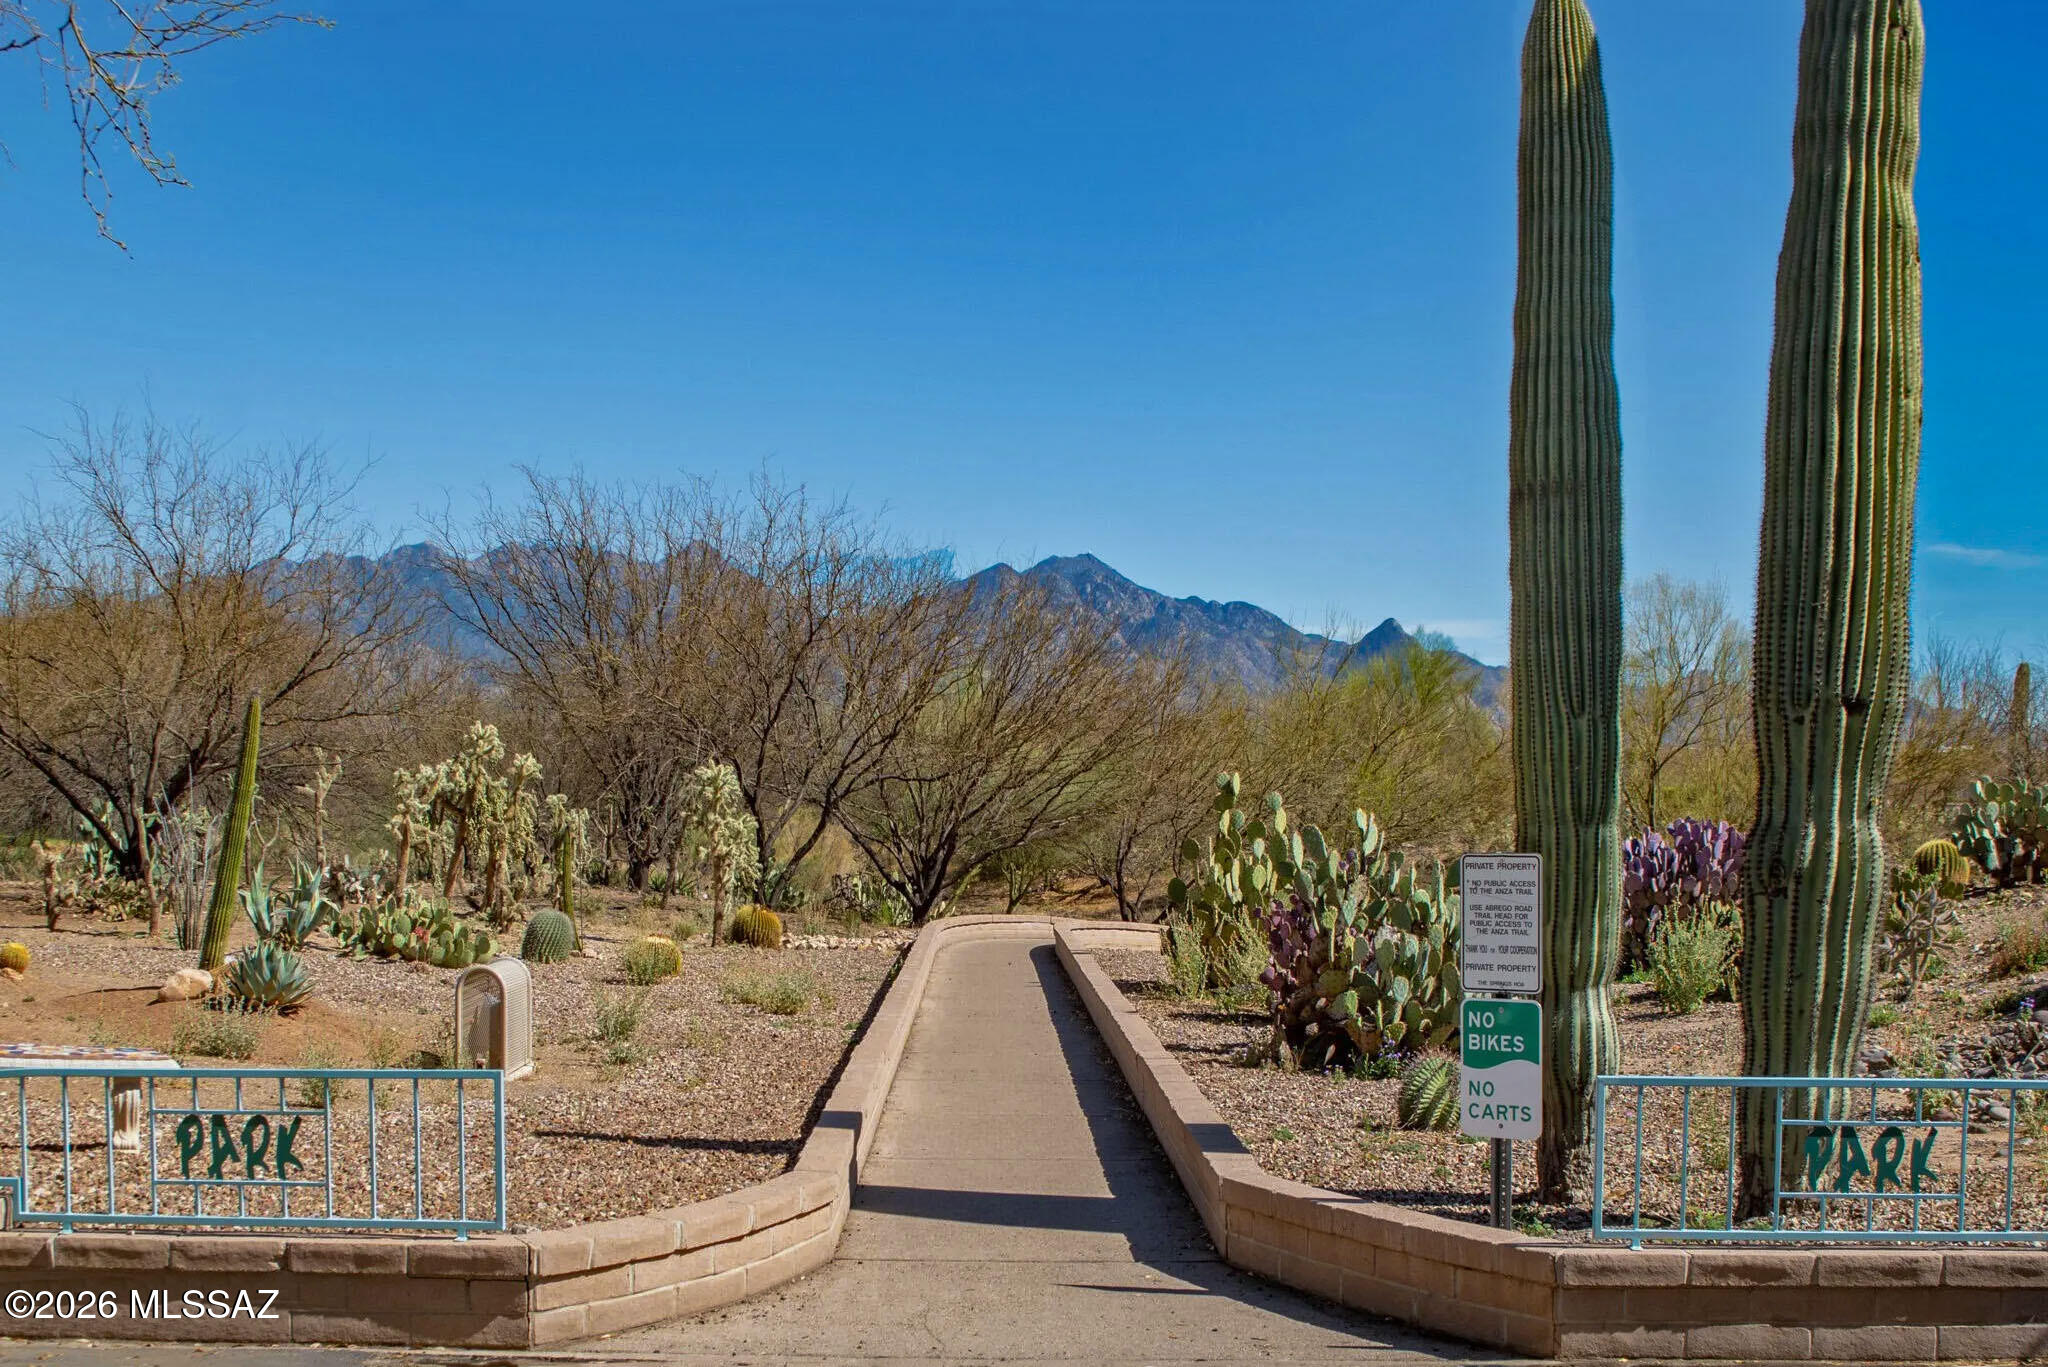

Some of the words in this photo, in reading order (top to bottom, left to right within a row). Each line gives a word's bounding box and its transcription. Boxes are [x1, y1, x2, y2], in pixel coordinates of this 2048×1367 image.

[1497, 862, 1536, 870] PROPERTY
[1479, 944, 1488, 953] YOU
[1510, 946, 1537, 954] COOPERATION
[1465, 963, 1494, 971] PRIVATE
[1497, 964, 1536, 972] PROPERTY
[1468, 1011, 1495, 1028] NO
[1468, 1033, 1525, 1053] BIKES
[1468, 1080, 1495, 1097] NO
[1468, 1103, 1532, 1122] CARTS
[176, 1114, 304, 1180] PARK
[1805, 1126, 1939, 1193] PARK
